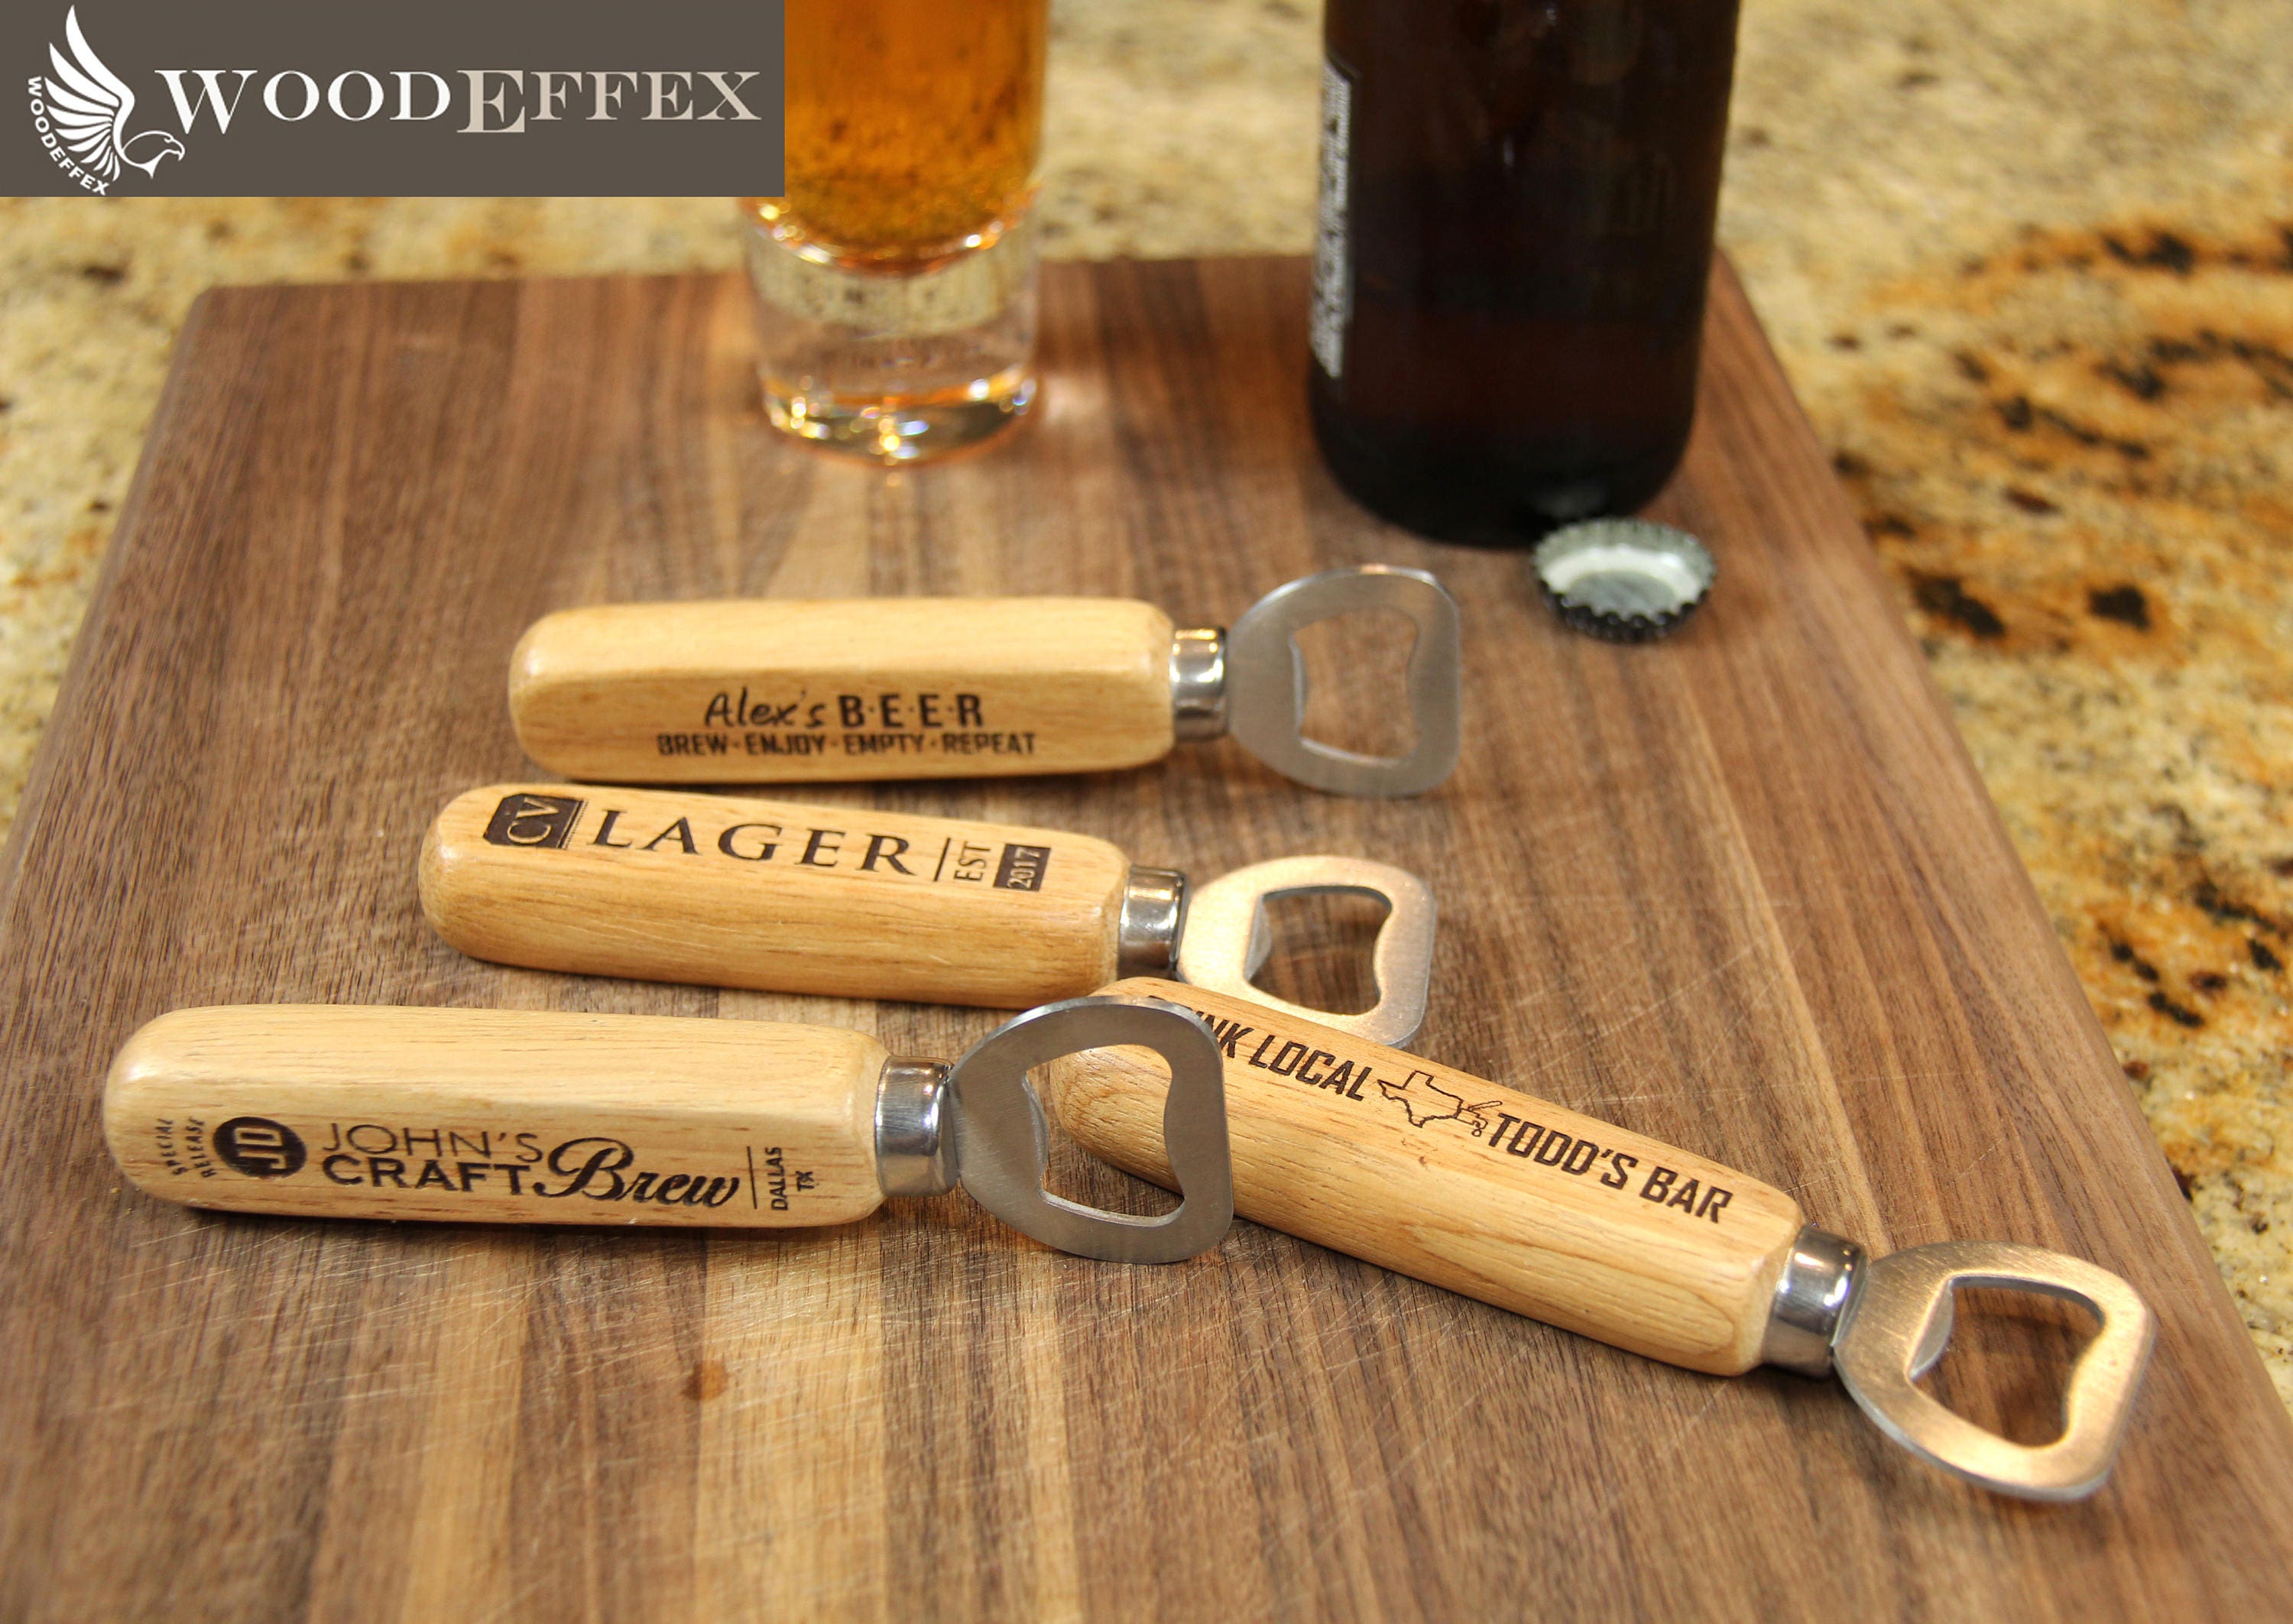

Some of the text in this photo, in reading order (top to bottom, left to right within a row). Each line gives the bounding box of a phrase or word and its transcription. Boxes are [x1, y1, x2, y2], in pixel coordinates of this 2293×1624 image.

[703, 687, 828, 728] Alex's
[657, 732, 1036, 757] BREW ENJOY EMPTY REPEAT
[507, 796, 559, 844] CV
[587, 808, 917, 877] LAGER
[953, 841, 991, 881] EST
[1005, 846, 1041, 889] 2017
[1248, 1034, 1370, 1103] LOCAL
[155, 1118, 189, 1175] SPECIAL
[186, 1117, 217, 1178] RELEASE
[322, 1123, 543, 1162] JOHN'S
[1488, 1112, 1733, 1224] TODD'S BAR
[322, 1136, 740, 1207] CRAFT Brew
[765, 1147, 788, 1211] DALLAS
[796, 1171, 815, 1191] TX
